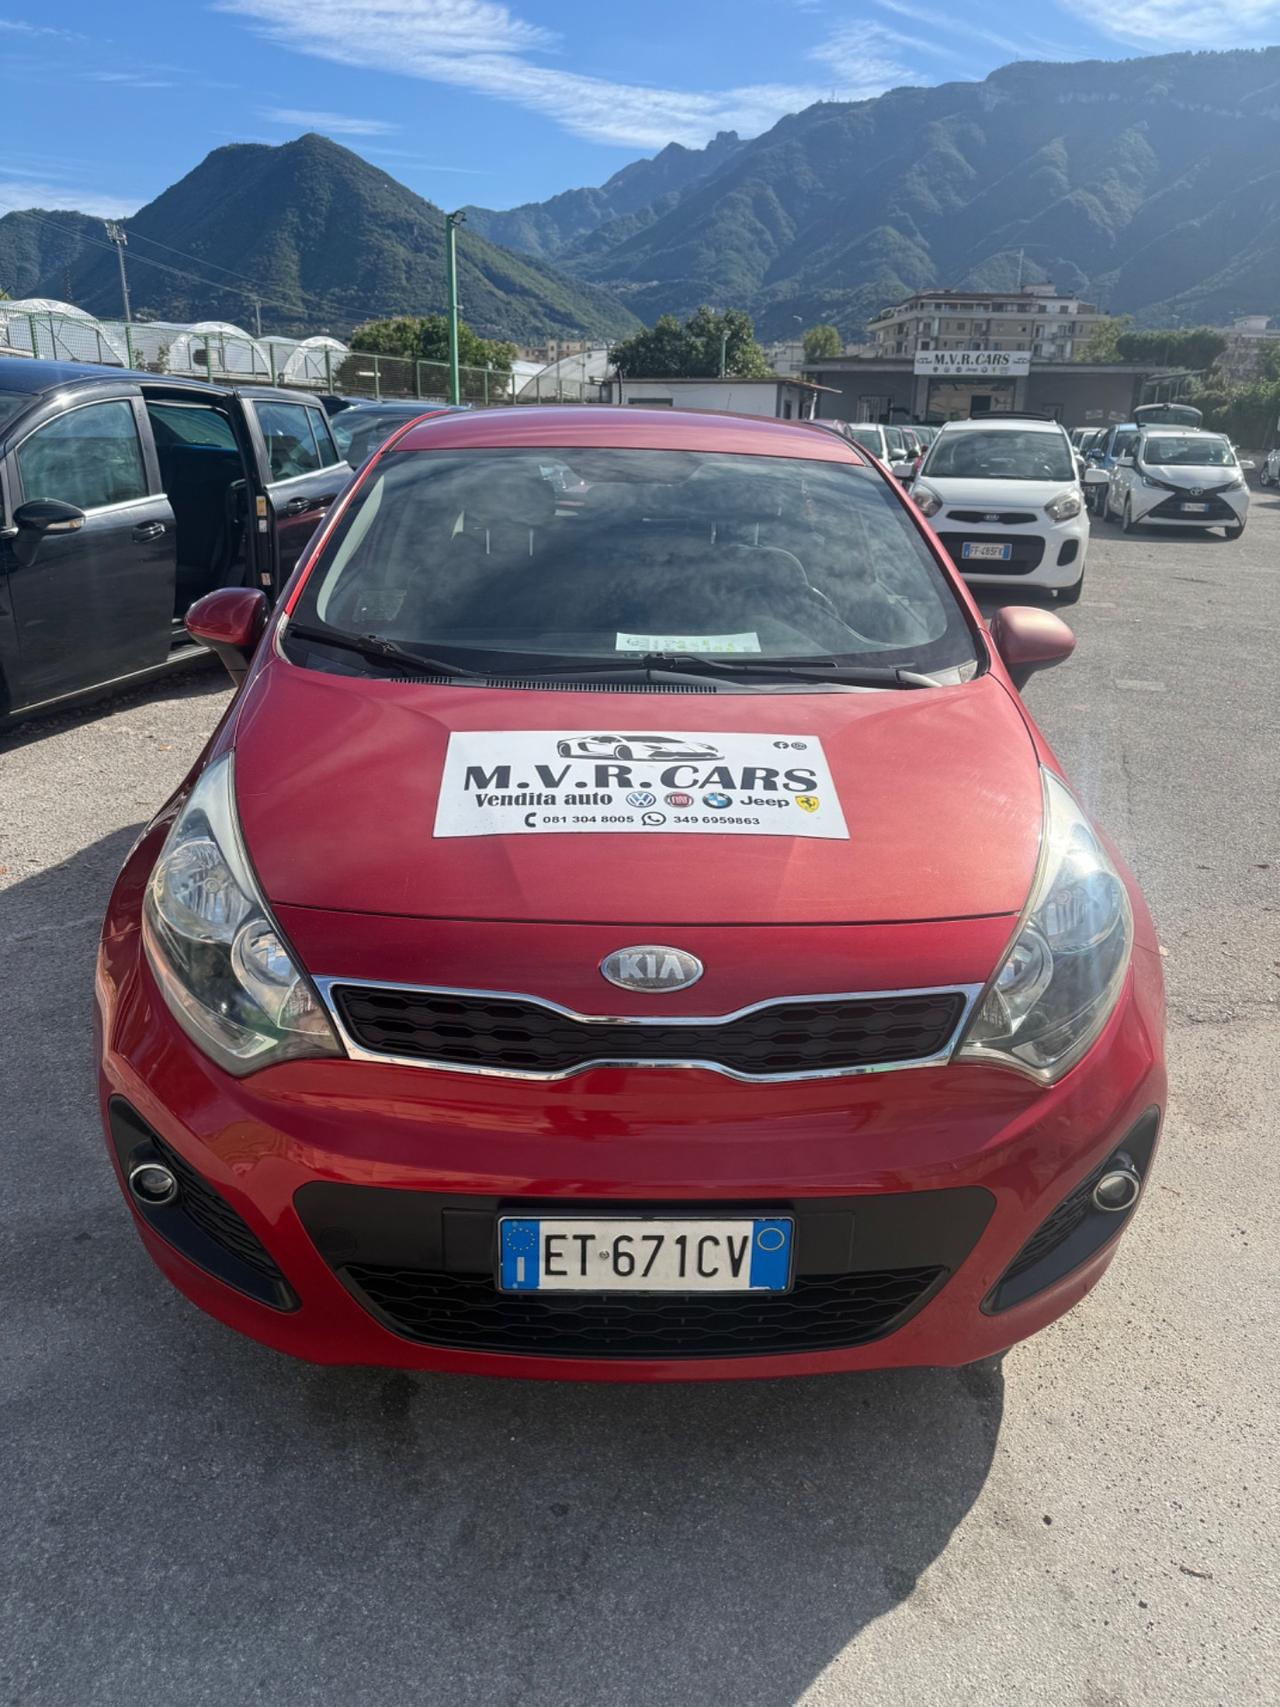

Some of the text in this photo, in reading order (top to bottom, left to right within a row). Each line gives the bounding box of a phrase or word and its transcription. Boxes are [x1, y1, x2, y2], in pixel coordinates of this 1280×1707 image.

[475, 792, 613, 807] Vendita auto
[740, 796, 790, 808] Jeep
[543, 815, 634, 824] 081 304 8005
[673, 816, 760, 825] 349 6959863
[618, 953, 685, 979] KIA
